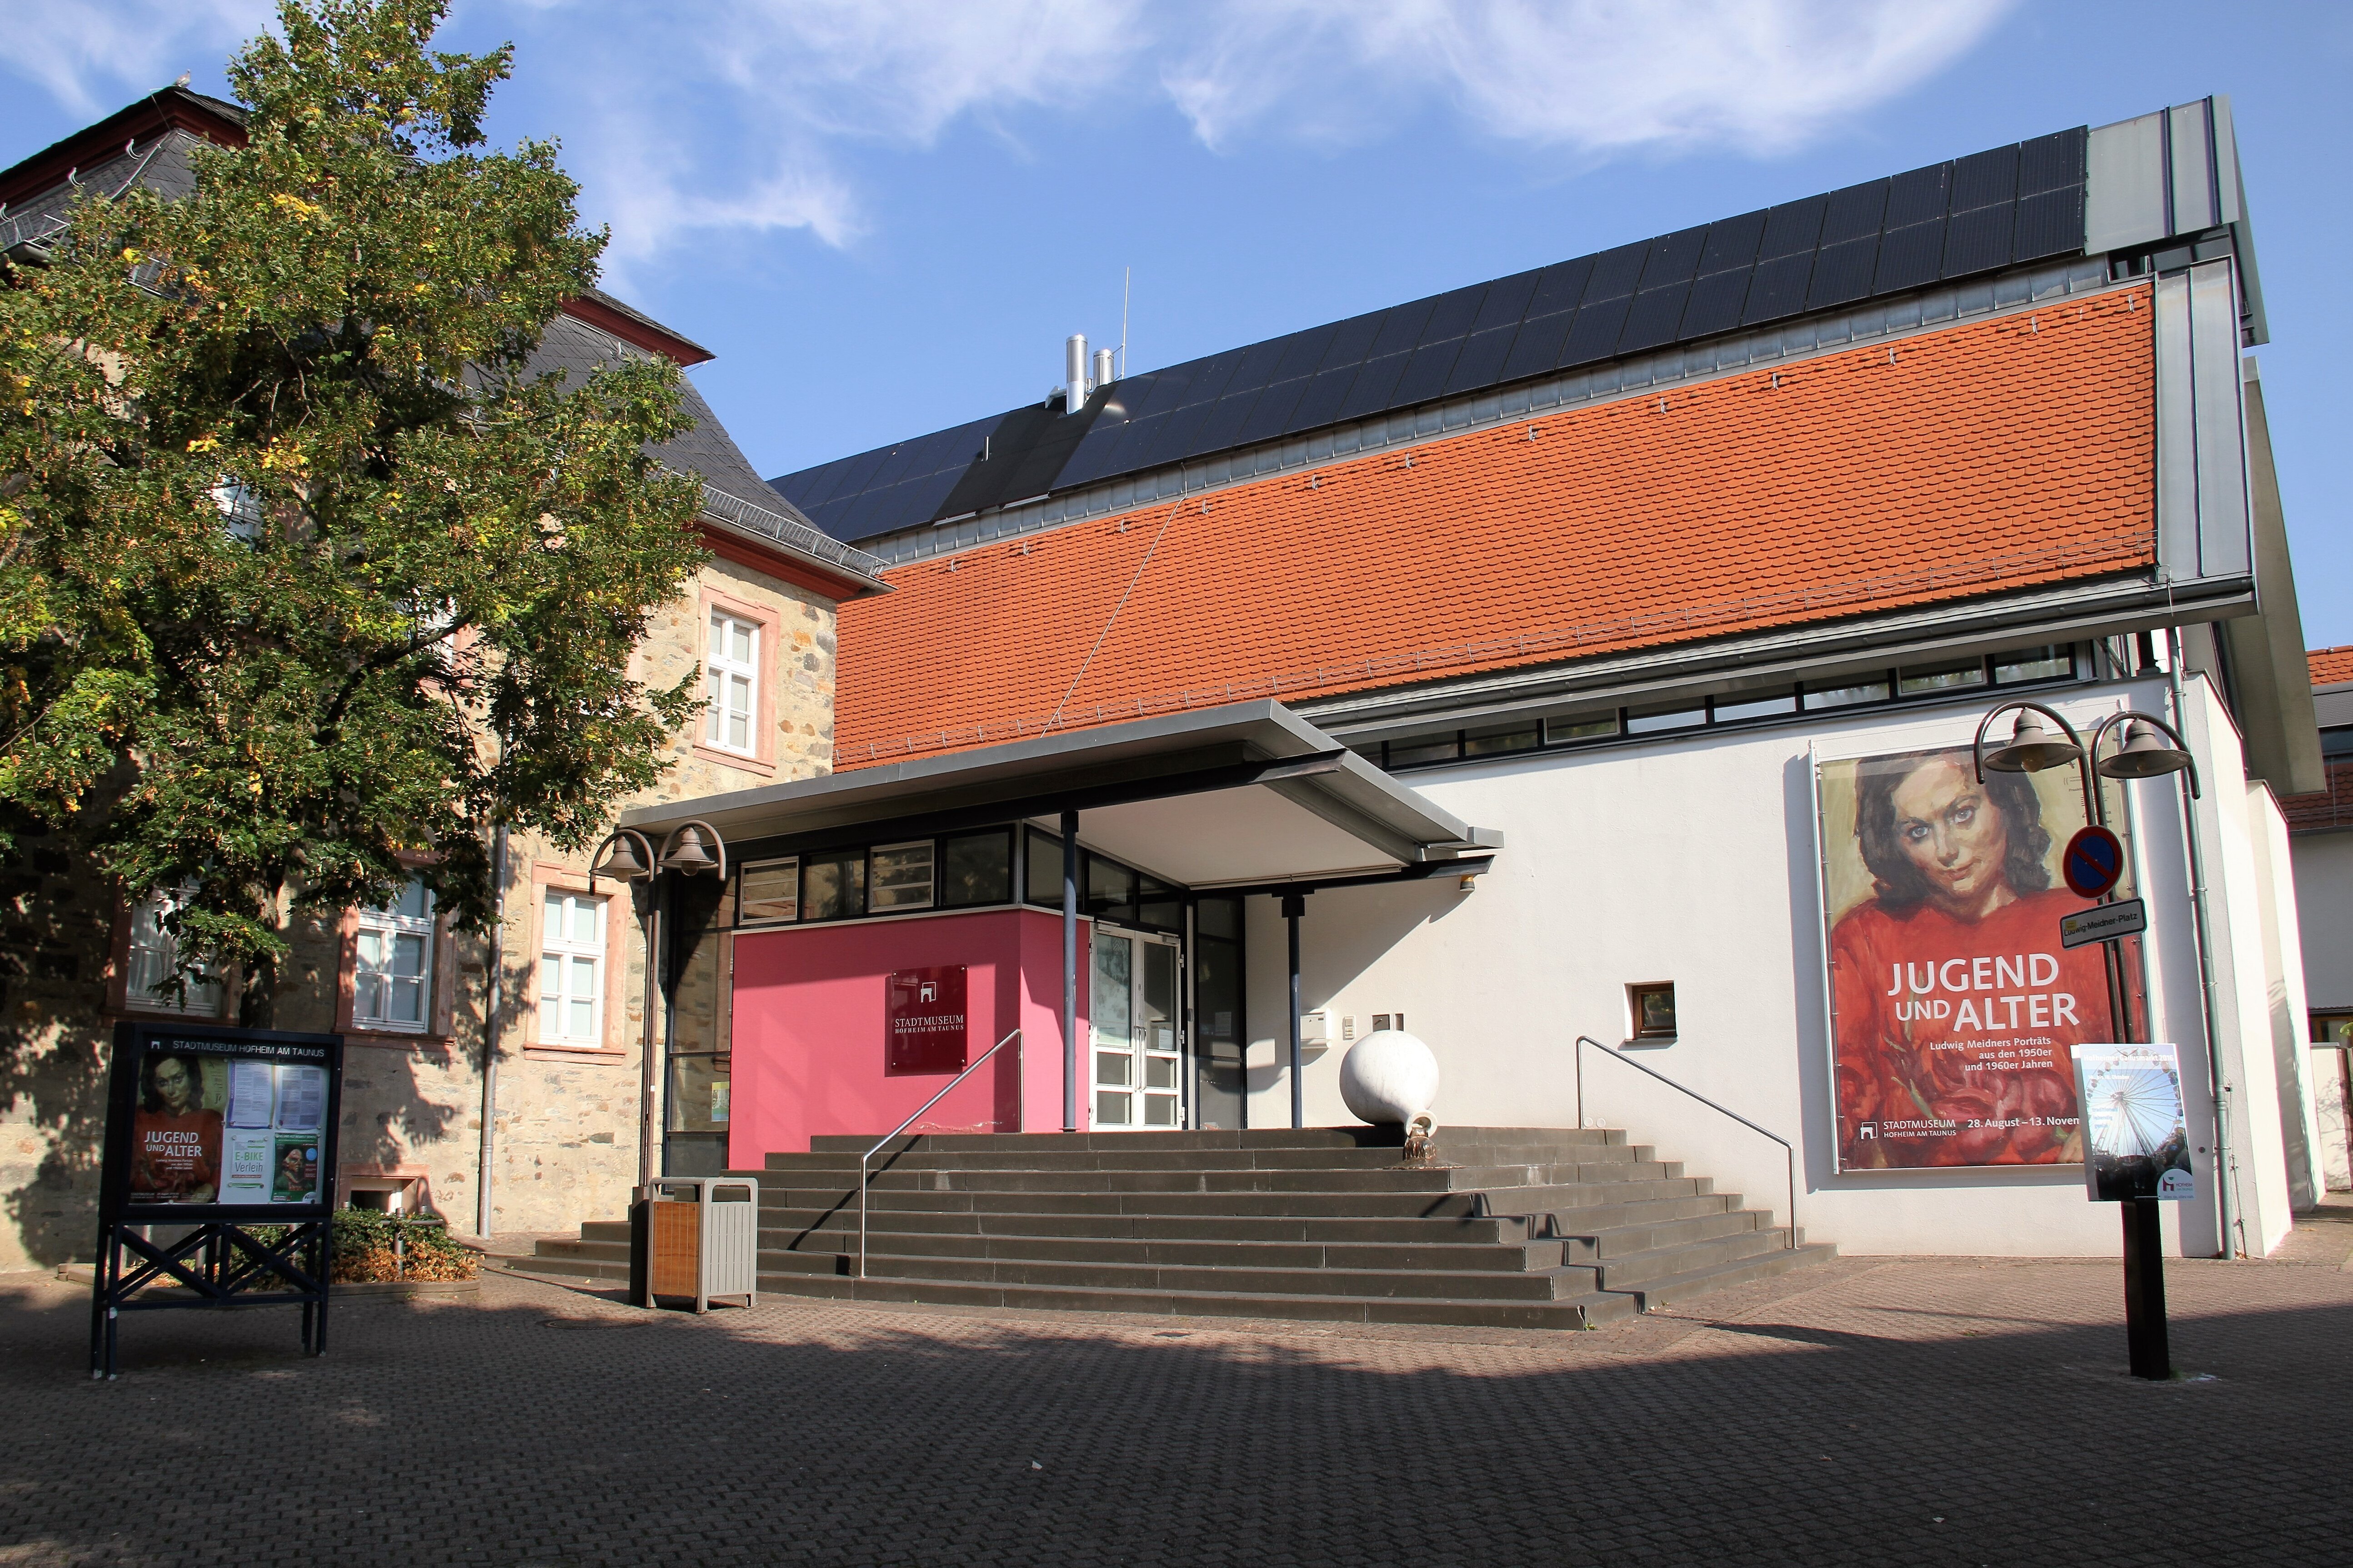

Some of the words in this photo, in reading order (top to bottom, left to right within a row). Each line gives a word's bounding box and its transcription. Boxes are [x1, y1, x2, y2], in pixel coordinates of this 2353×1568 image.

[1887, 953, 2059, 996] JUGEND
[1896, 1000, 1951, 1021] UND
[1953, 993, 2080, 1033] ALTER
[895, 1014, 964, 1027] STADTMUSEUM
[173, 1040, 237, 1052] STADTMUSEUM
[240, 1045, 275, 1054] HOFHEIM
[277, 1047, 290, 1055] AM
[292, 1048, 325, 1057] TAUNUS
[1930, 1041, 1964, 1051] Ludwig
[1967, 1039, 2011, 1049] Meidners
[2013, 1036, 2051, 1046] Porträts
[1998, 1050, 2015, 1058] den
[2018, 1049, 2053, 1057] 1950er
[1965, 1063, 1983, 1071] und
[1986, 1061, 2019, 1070] 1960er
[2021, 1059, 2053, 1069] Jahren
[1883, 1119, 1956, 1130] STADTMUSEUM
[1967, 1119, 1983, 1128] 28.
[1985, 1118, 2020, 1129] August
[2029, 1117, 2045, 1126] 13.
[144, 1131, 199, 1144] JUGEND
[165, 1145, 202, 1157] ALTER
[235, 1151, 264, 1161] E-BIKE
[235, 1162, 263, 1172] Verleih
